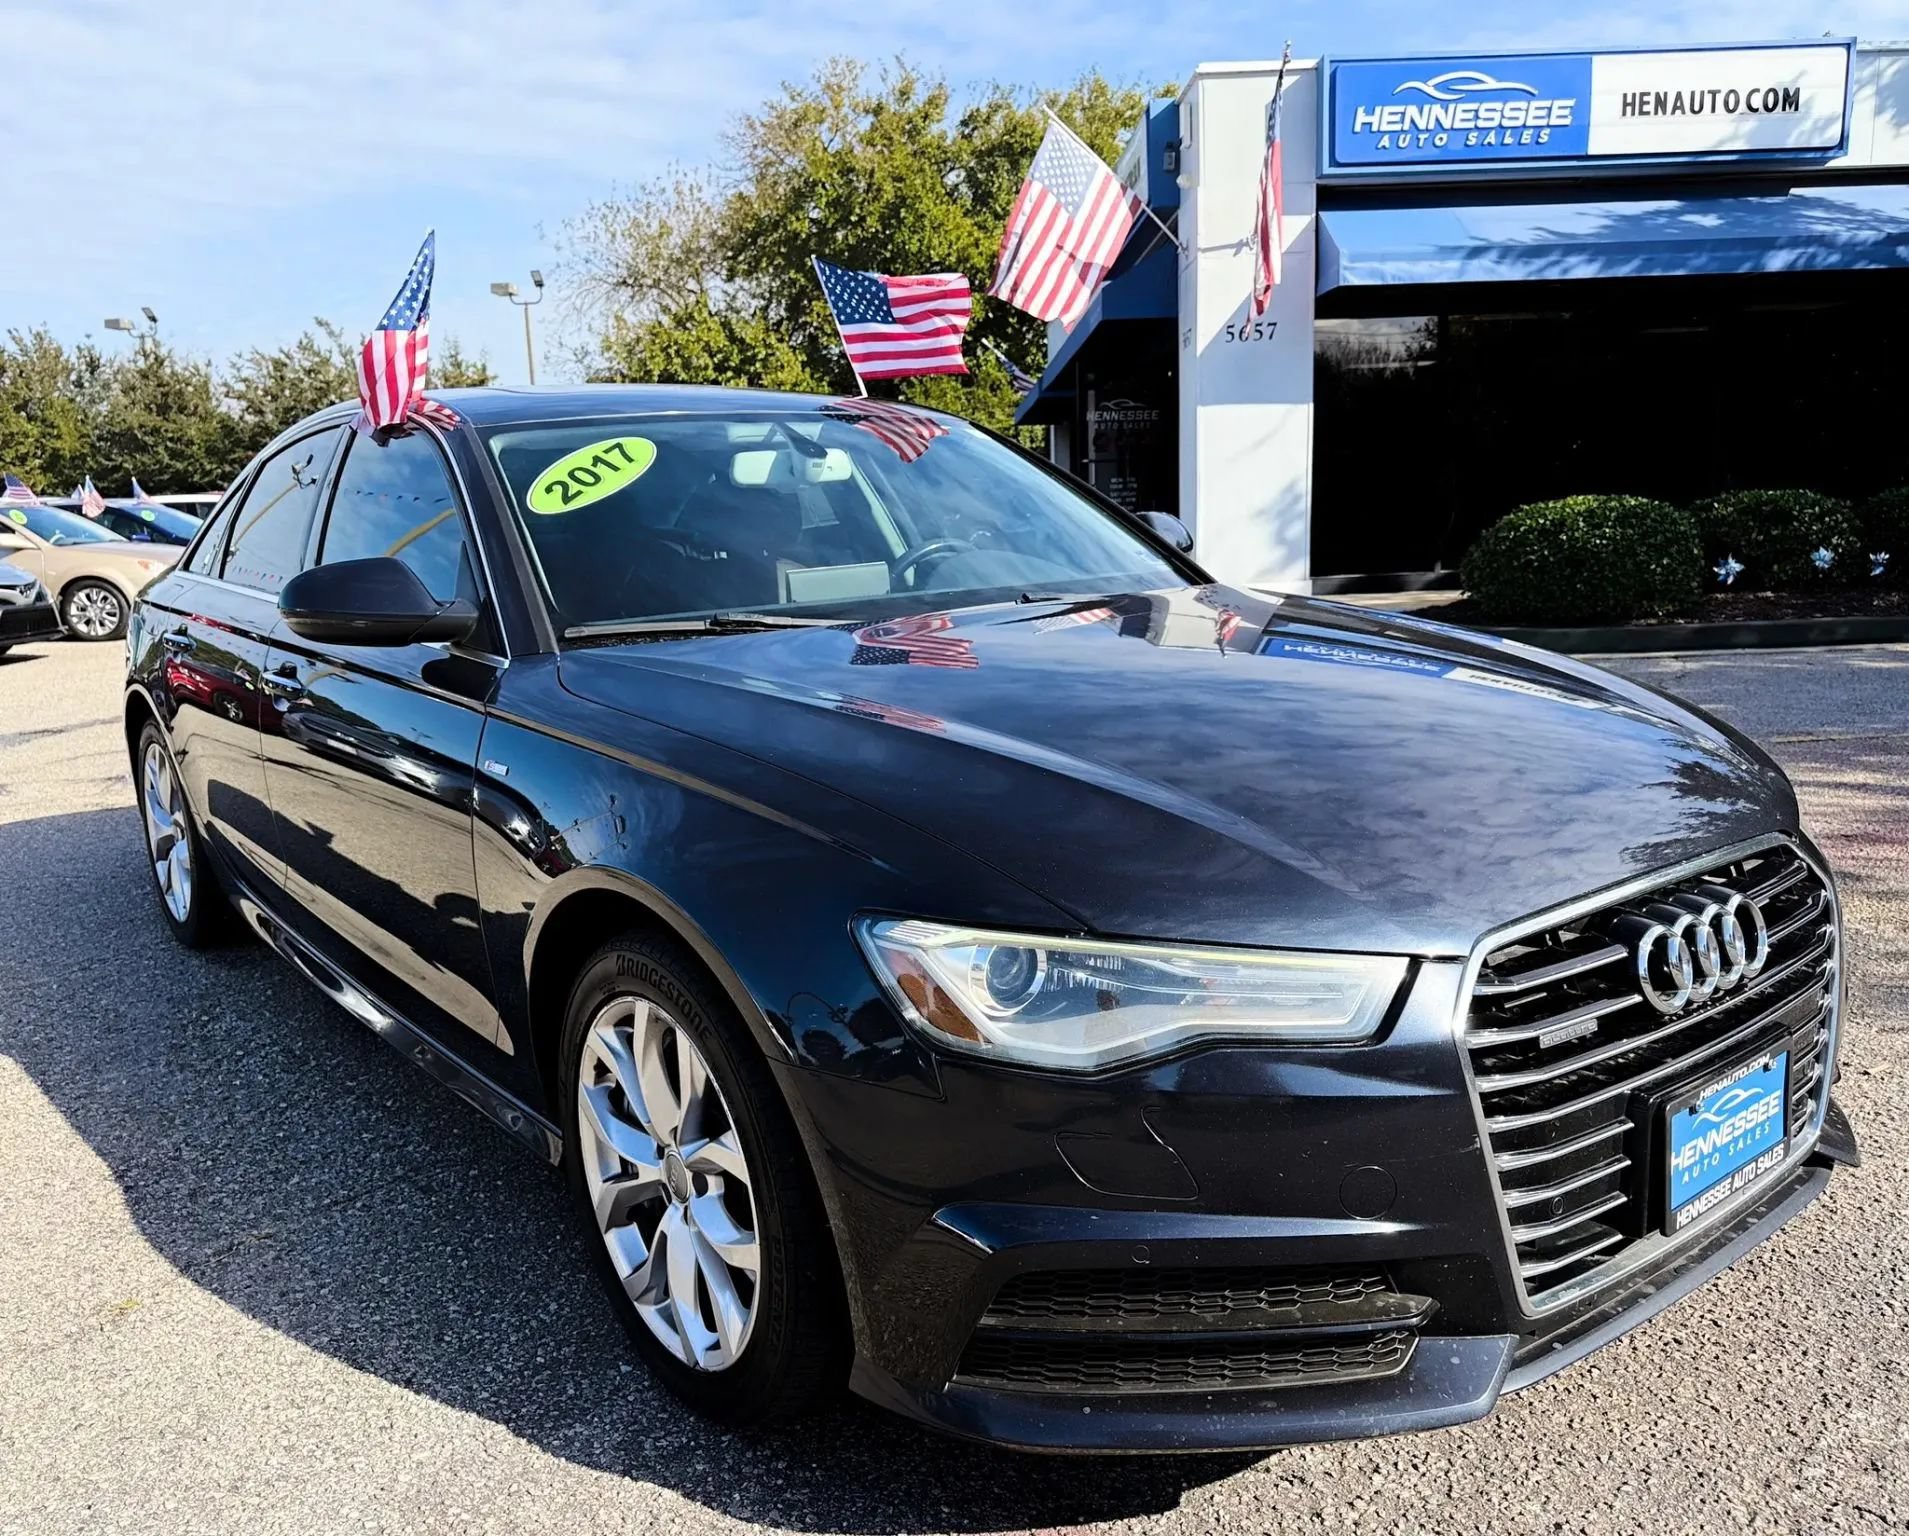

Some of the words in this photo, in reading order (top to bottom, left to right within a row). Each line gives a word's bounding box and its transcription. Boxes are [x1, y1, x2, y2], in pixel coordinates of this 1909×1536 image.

[1353, 98, 1576, 133] HENNESSEE
[1376, 131, 1448, 149] AUTO
[1464, 129, 1550, 146] SALES
[1225, 321, 1278, 343] 5657
[1086, 409, 1160, 421] HENNESSEE
[544, 441, 635, 506] 2017
[615, 953, 714, 1041] BRIDGESTONE
[1699, 1052, 1771, 1102] HENAUTO.COM
[1671, 1088, 1781, 1176] HENNESSEE
[1681, 1154, 1720, 1185] AUTO
[1728, 1121, 1771, 1157] SALES
[1676, 1177, 1732, 1231] HENNESSEE
[1732, 1165, 1756, 1196] AUTO
[1757, 1143, 1785, 1173] SALES
